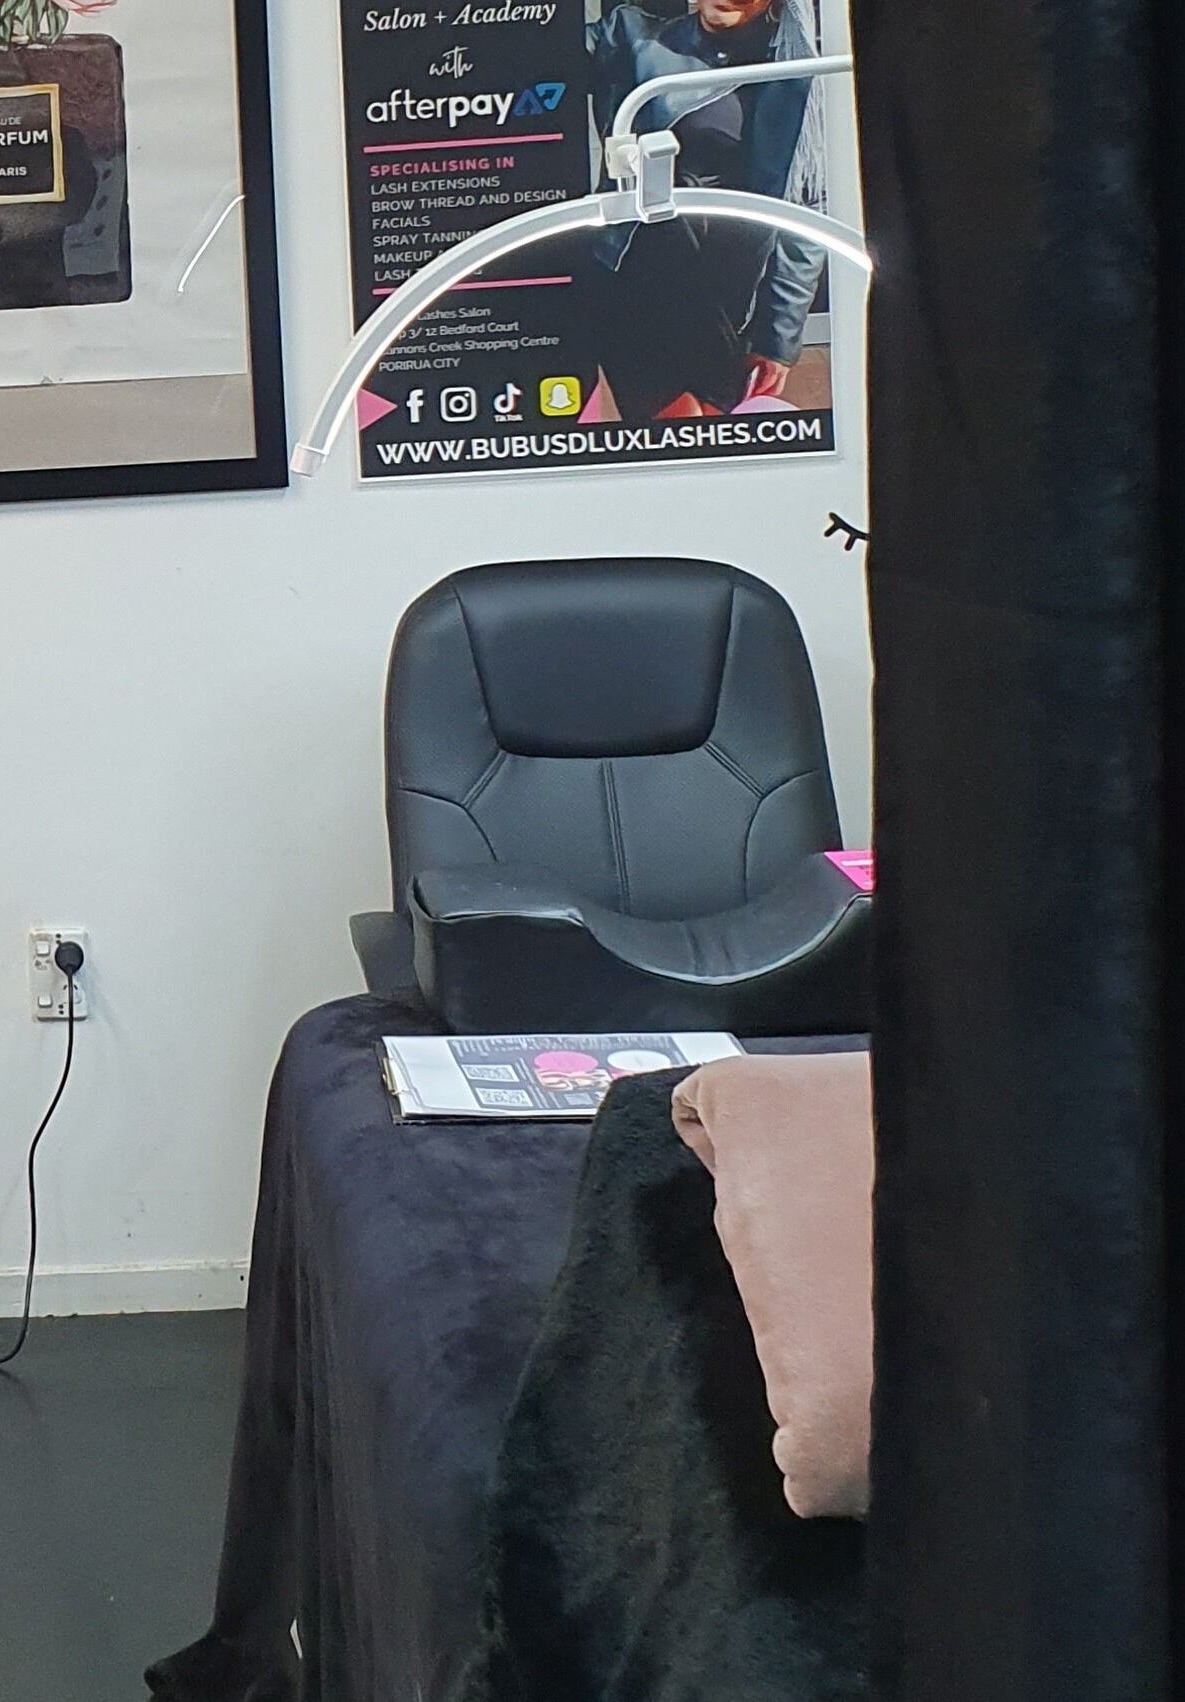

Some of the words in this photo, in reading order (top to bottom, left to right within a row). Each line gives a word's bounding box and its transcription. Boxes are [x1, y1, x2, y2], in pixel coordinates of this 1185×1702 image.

[364, 8, 427, 32] Salon
[451, 0, 557, 26] Academy
[429, 45, 474, 79] with
[366, 88, 515, 128] afterpay
[370, 157, 490, 178] SPECIALISING
[496, 156, 515, 169] IN
[370, 183, 407, 196] LASH
[411, 175, 501, 192] EXTENSIONS
[371, 199, 415, 213] BROW
[420, 194, 475, 209] THREAD
[478, 192, 510, 206] AND
[514, 189, 567, 204] DESIGN
[371, 215, 431, 230] FACIALS
[372, 234, 418, 248] SPRAY
[373, 250, 433, 265] MAKEUP
[374, 268, 411, 283] LASH
[458, 307, 492, 319] Salon
[439, 324, 486, 336] Bedford
[487, 321, 520, 333] Court
[428, 342, 463, 353] Creek
[464, 340, 519, 352] Shopping
[520, 336, 561, 347] Centre
[378, 359, 432, 373] PORIRUA
[432, 357, 461, 369] CITY
[377, 420, 822, 464] WWW.BUBUSDLUXLASHES.COM
